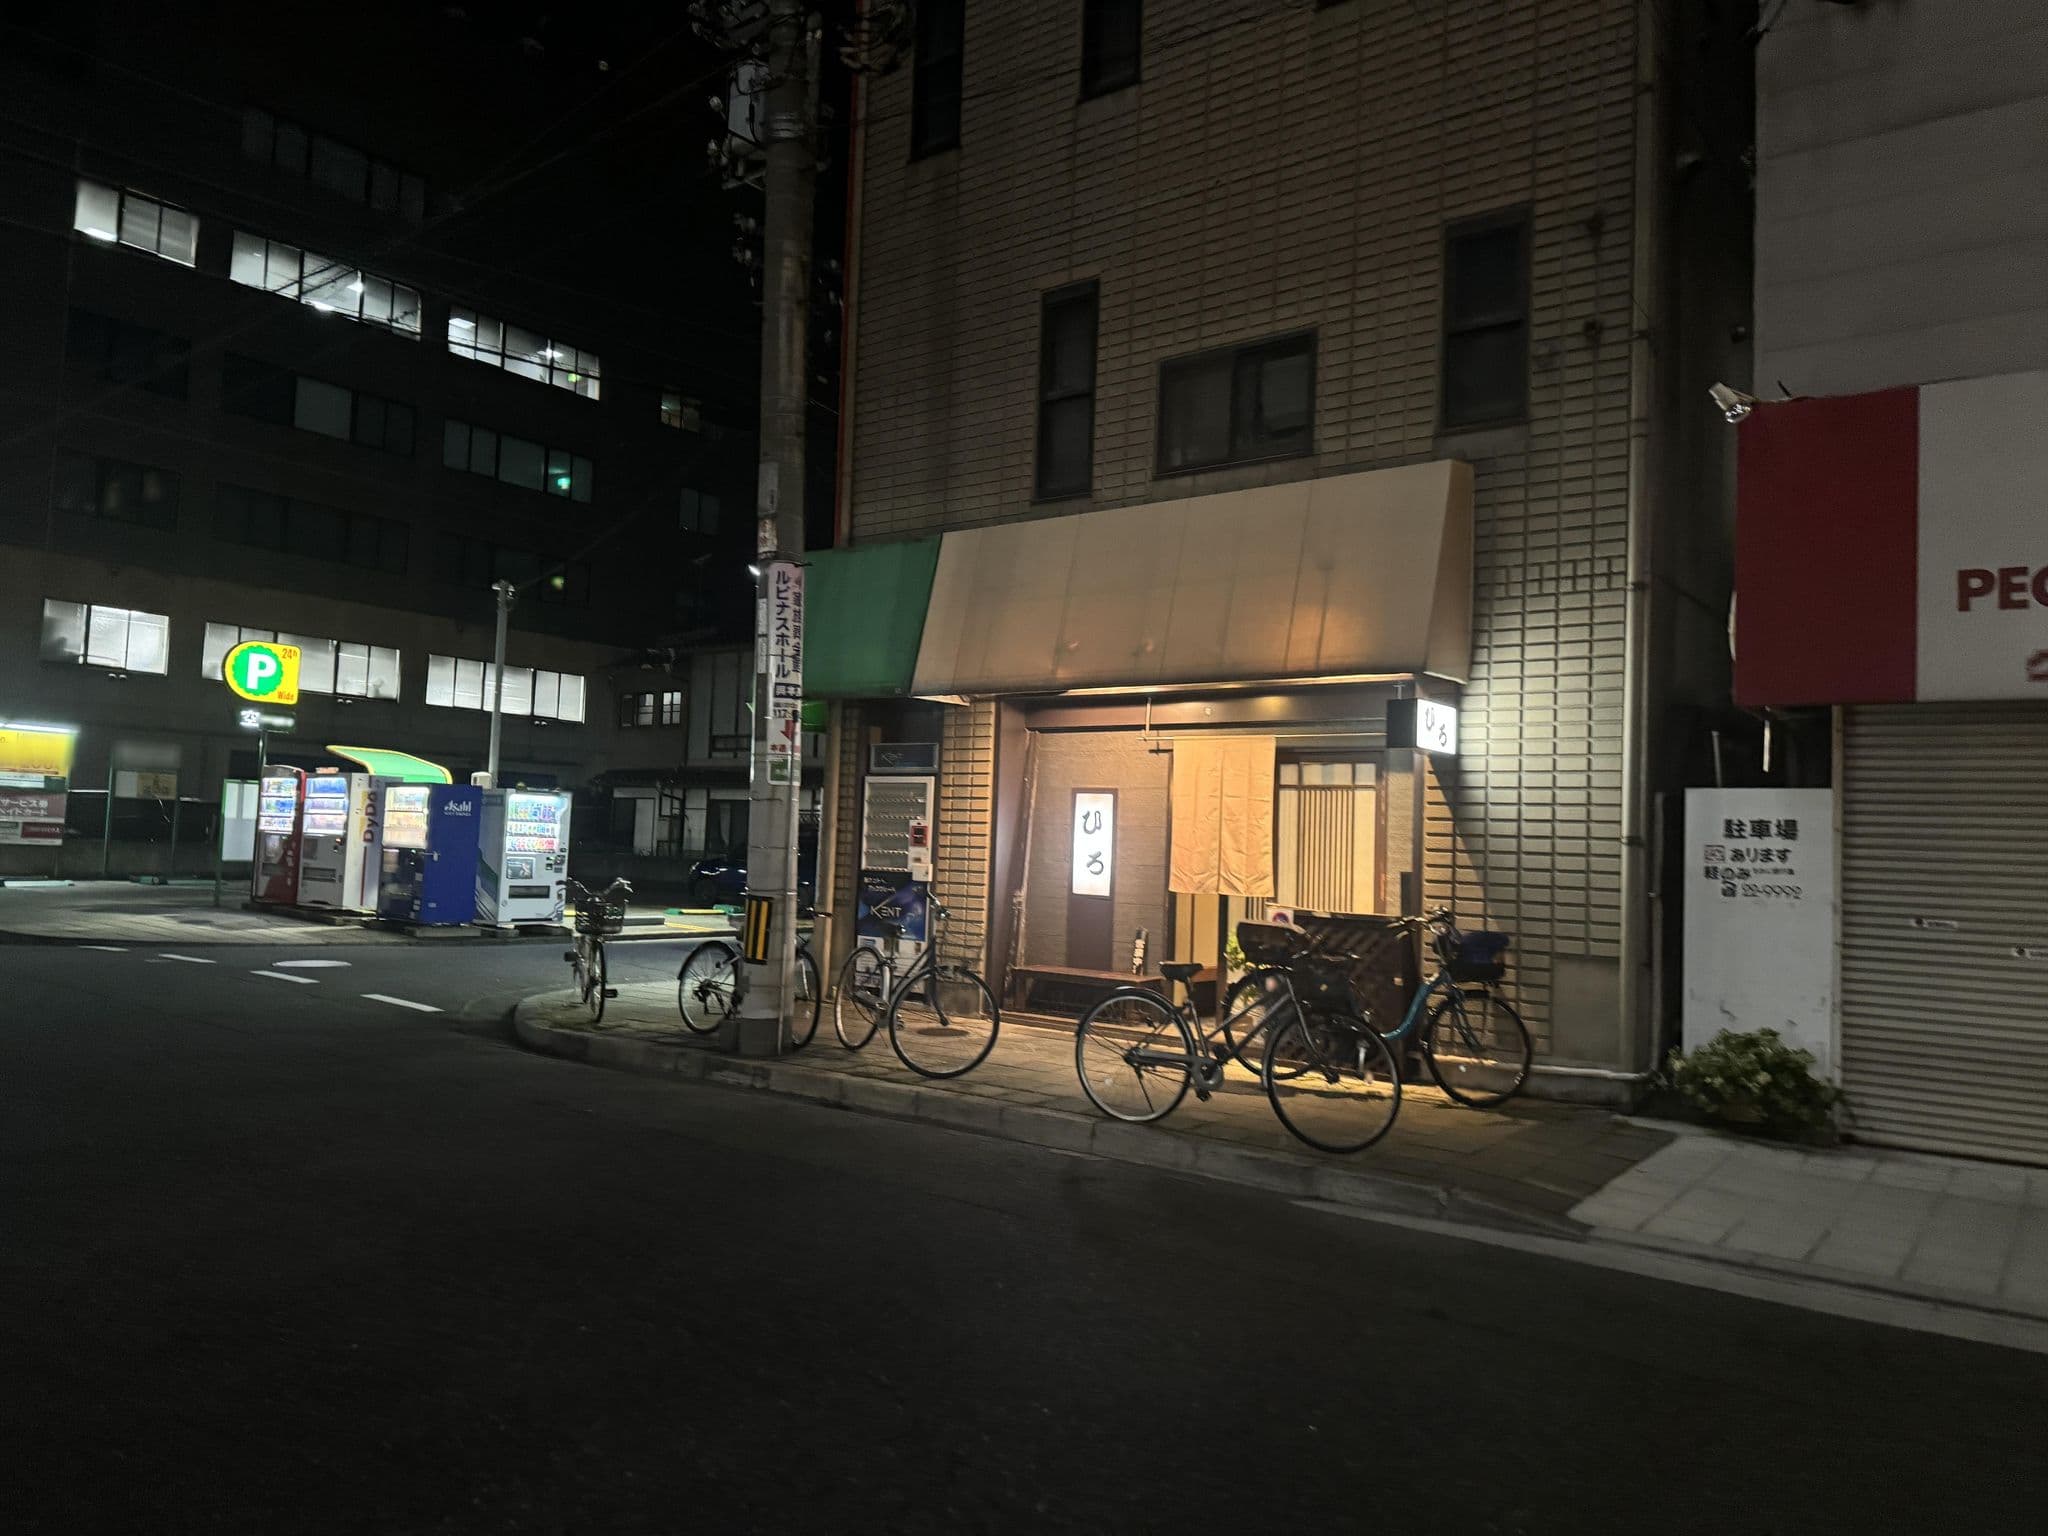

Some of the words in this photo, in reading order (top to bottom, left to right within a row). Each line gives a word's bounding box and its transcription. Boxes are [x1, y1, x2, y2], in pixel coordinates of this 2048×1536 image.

[775, 570, 791, 679] ルビナスホール
[246, 652, 278, 690] P
[1425, 707, 1448, 747] ひろ
[363, 790, 381, 844] DyDo
[444, 800, 472, 812] Asahi
[1082, 810, 1104, 875] ひろ
[1724, 818, 1798, 841] 駐車場
[1730, 847, 1792, 863] あります
[870, 899, 902, 919] KENT
